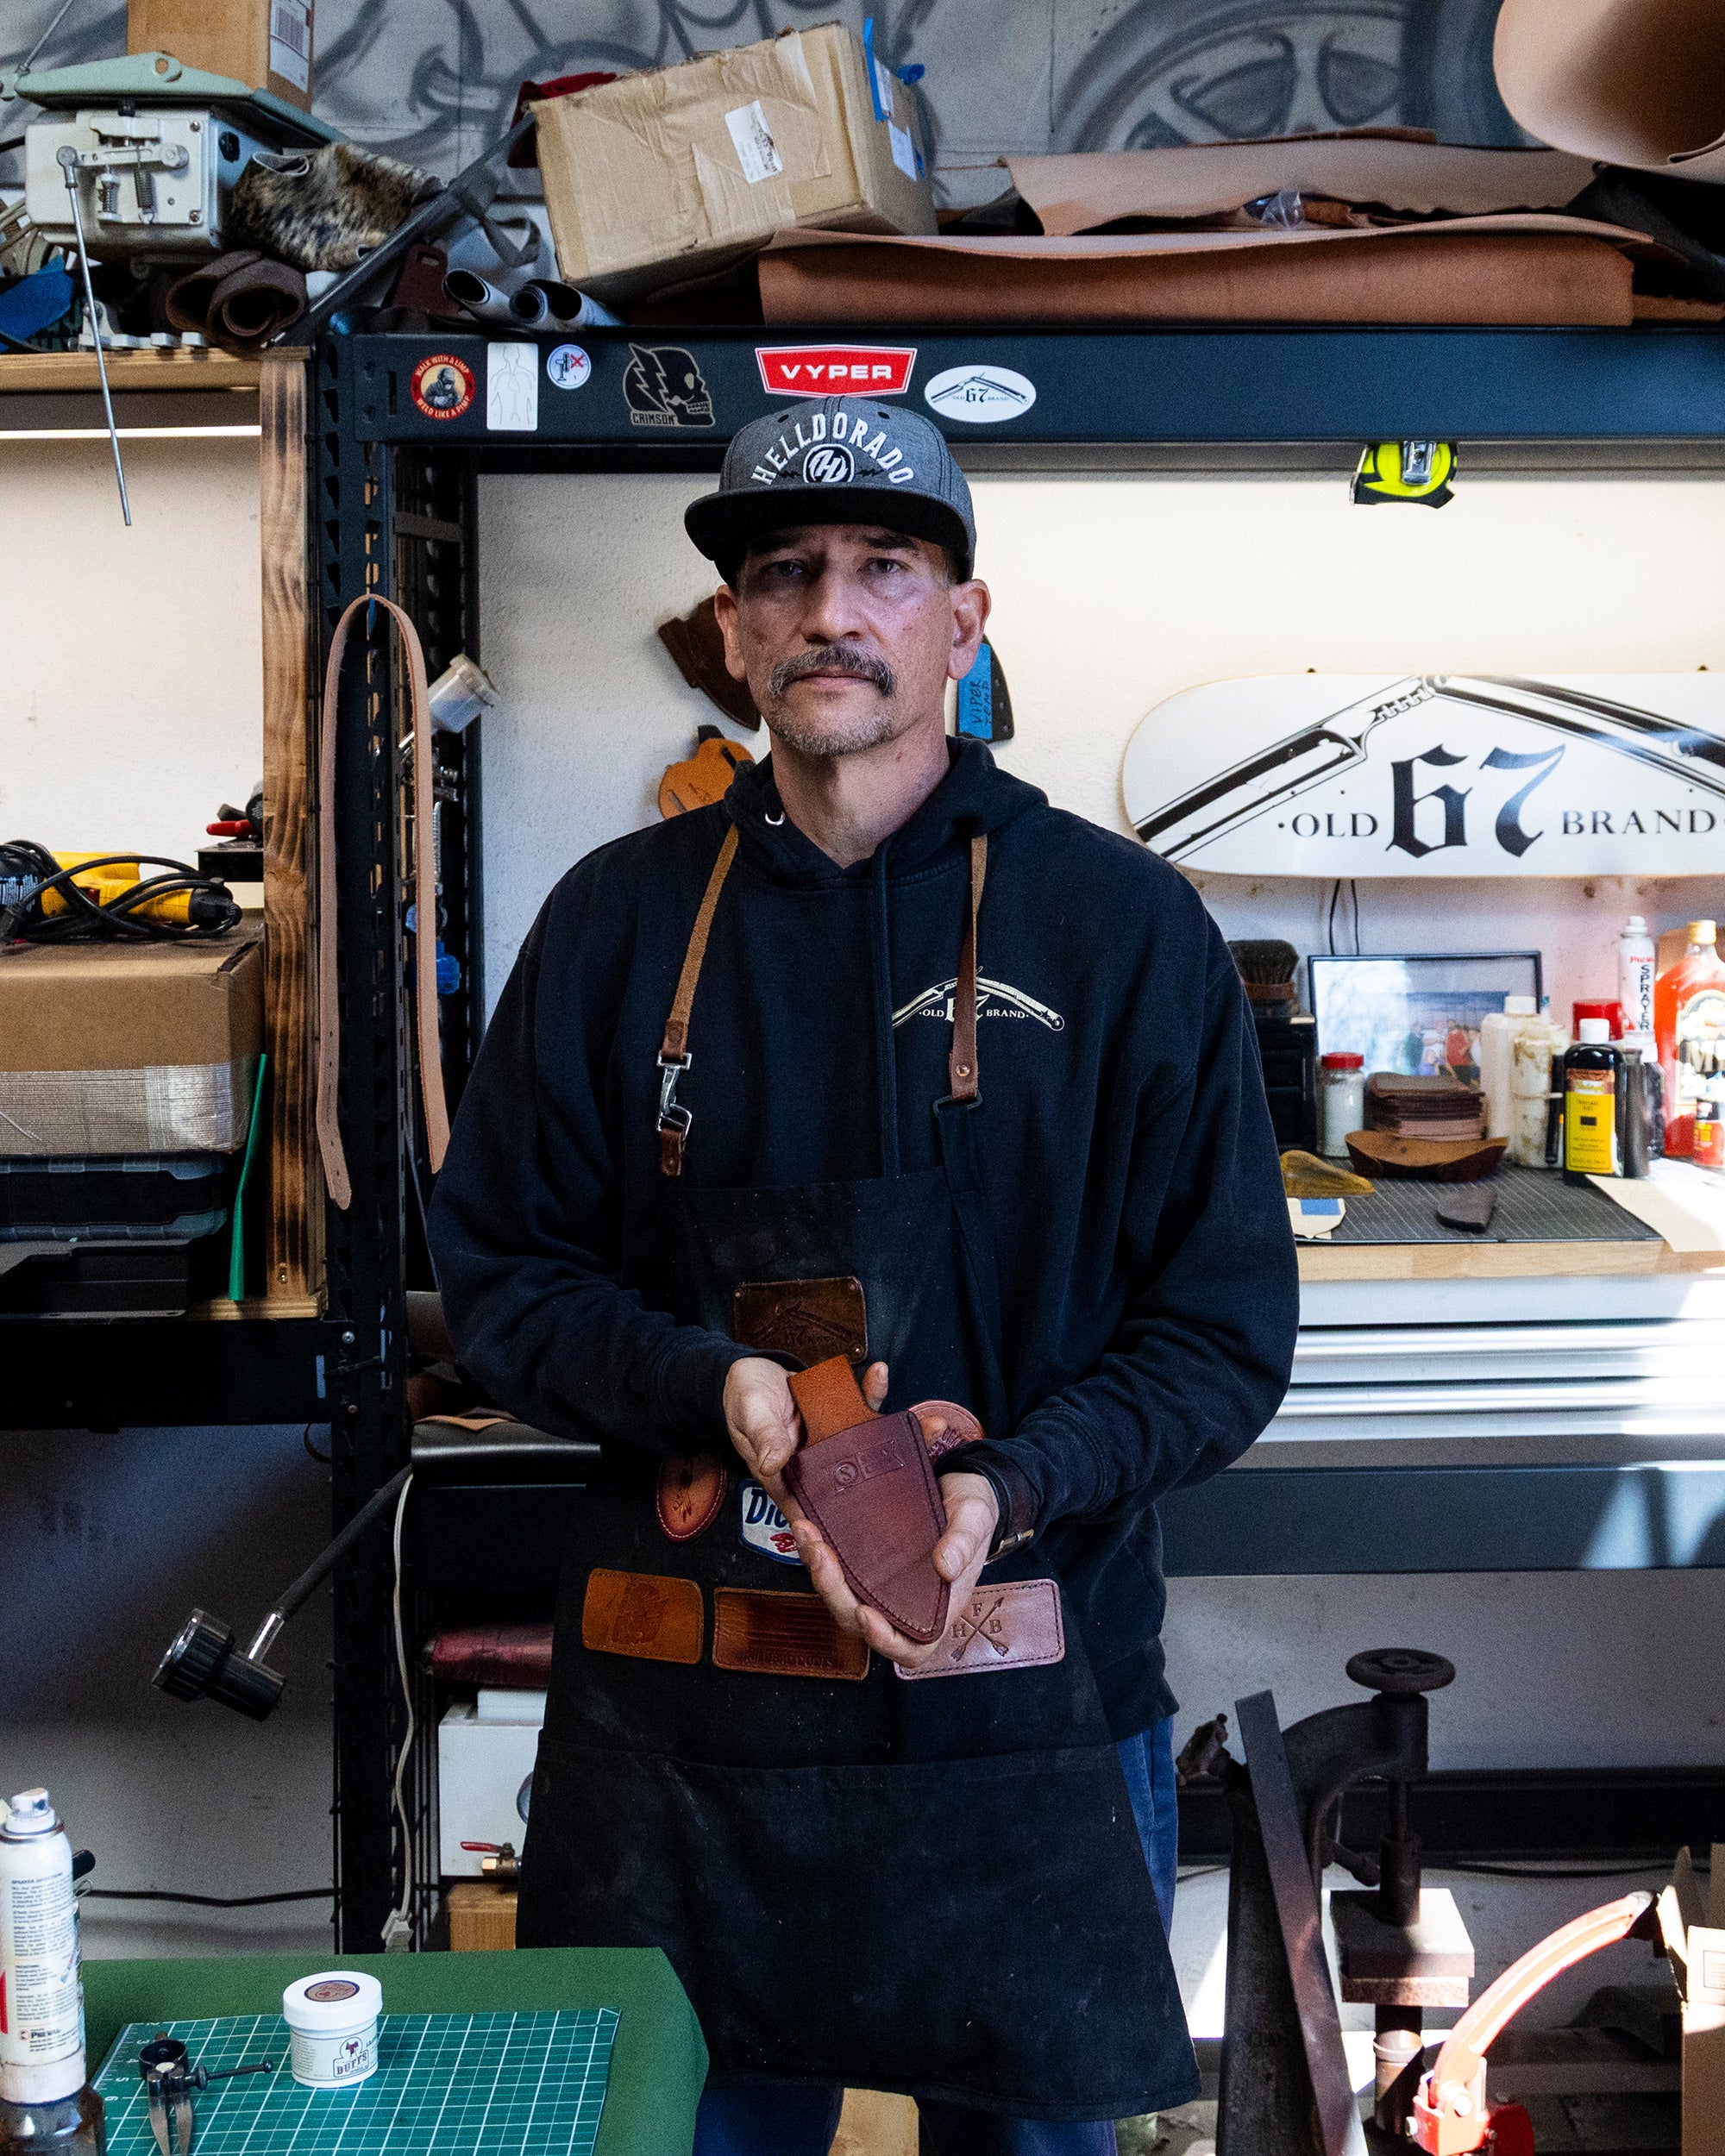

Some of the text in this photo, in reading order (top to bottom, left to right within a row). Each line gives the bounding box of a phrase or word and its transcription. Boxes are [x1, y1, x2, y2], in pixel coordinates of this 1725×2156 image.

[415, 360, 431, 376] WALK
[431, 354, 448, 363] WITH
[455, 359, 470, 374] LIMP
[781, 365, 892, 379] VYPER
[966, 387, 989, 403] 67
[435, 410, 449, 418] LIKE
[455, 396, 470, 412] PIMP
[632, 413, 675, 425] CRIMSON
[750, 411, 914, 485] HELLDORADO
[1291, 743, 1716, 858] OLD 67 BRAND
[1640, 964, 1651, 1030] SPRAYER
[922, 1008, 944, 1018] OLD
[986, 1009, 1025, 1018] BRAND
[972, 1602, 982, 1617] F
[951, 1623, 967, 1638] H
[989, 1620, 1002, 1634] B
[336, 2052, 367, 2075] DUFFS
